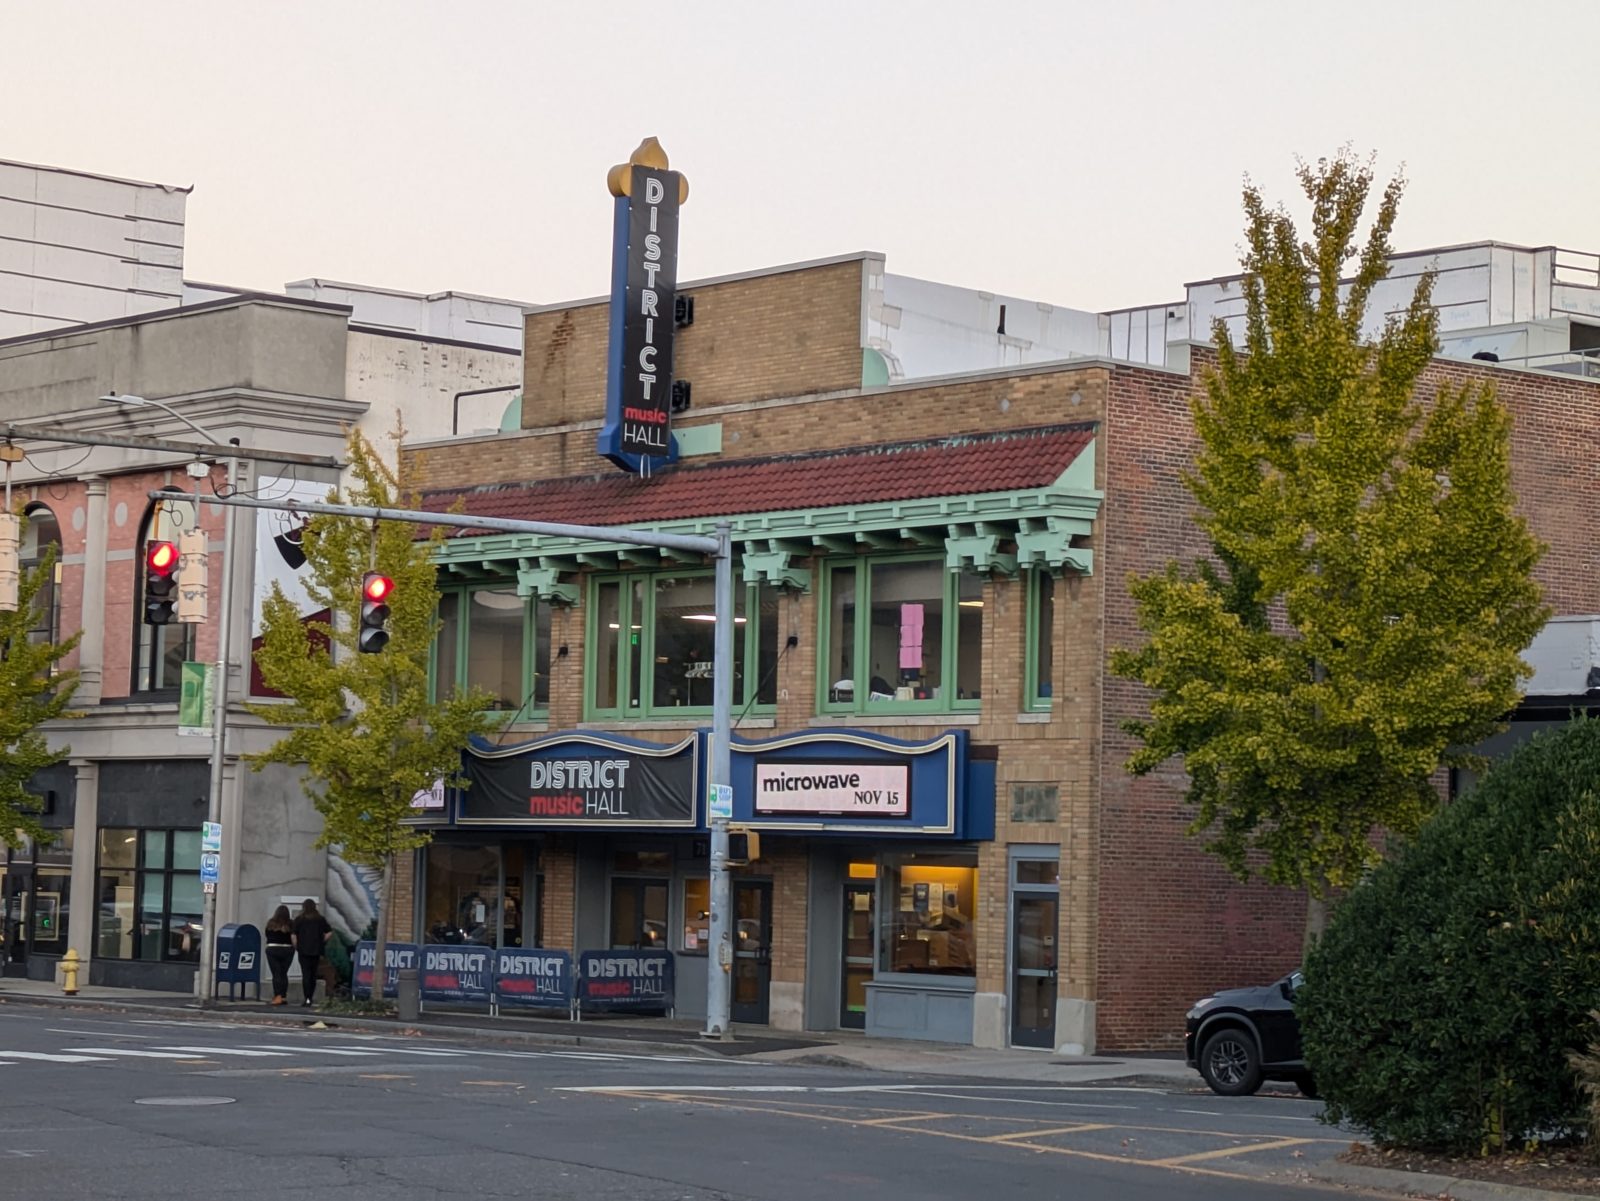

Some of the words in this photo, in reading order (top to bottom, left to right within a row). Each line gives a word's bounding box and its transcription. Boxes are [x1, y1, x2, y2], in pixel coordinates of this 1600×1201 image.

[639, 177, 665, 400] DISTRICT
[624, 406, 667, 424] music
[623, 422, 667, 447] HALL
[530, 760, 630, 789] DISTRICT
[763, 771, 860, 792] microwave
[529, 792, 584, 816] music
[586, 791, 629, 815] HALL
[854, 791, 882, 805] NOV
[887, 791, 899, 805] 15
[359, 949, 415, 969] DISRICT
[426, 952, 486, 973] DISTRICT
[500, 955, 564, 976] DISTRICT
[588, 958, 667, 977] DISTRICT
[458, 973, 485, 989] HALL
[536, 977, 564, 994] HALL
[633, 979, 666, 994] HALL
